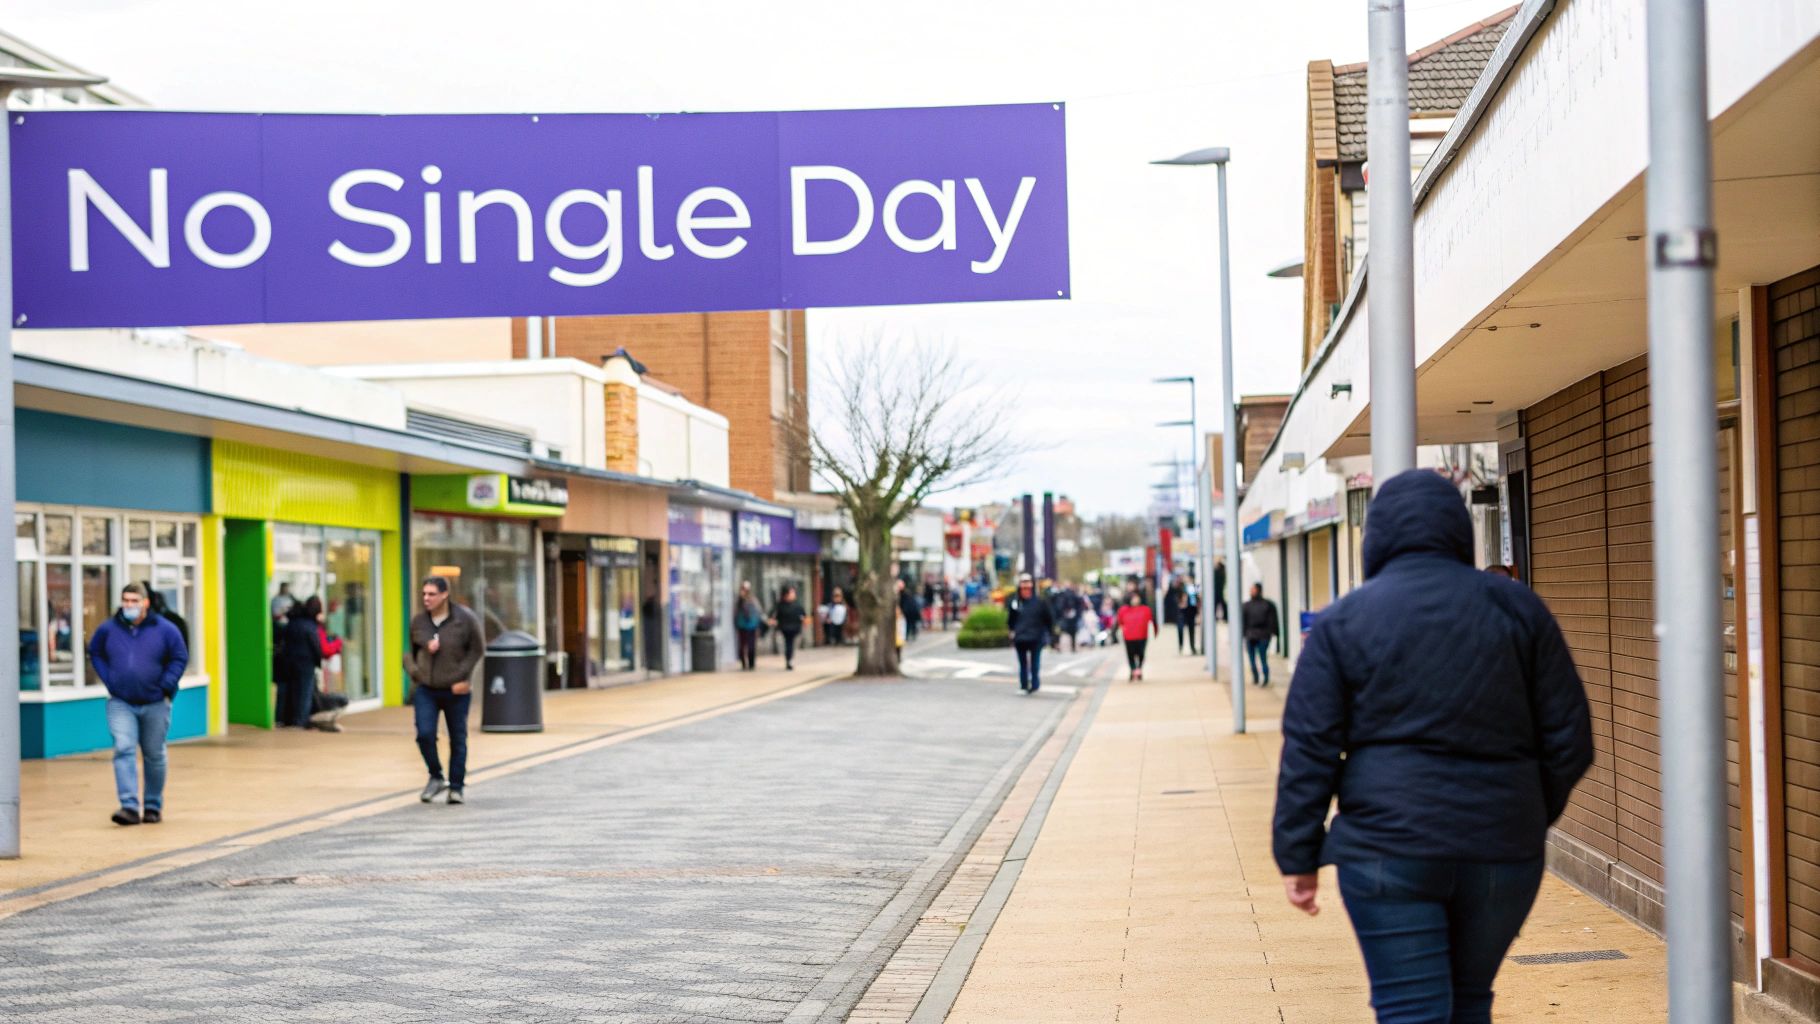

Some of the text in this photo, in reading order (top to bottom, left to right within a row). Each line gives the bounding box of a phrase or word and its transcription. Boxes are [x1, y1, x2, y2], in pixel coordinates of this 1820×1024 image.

[68, 164, 1037, 287] No Single Day
